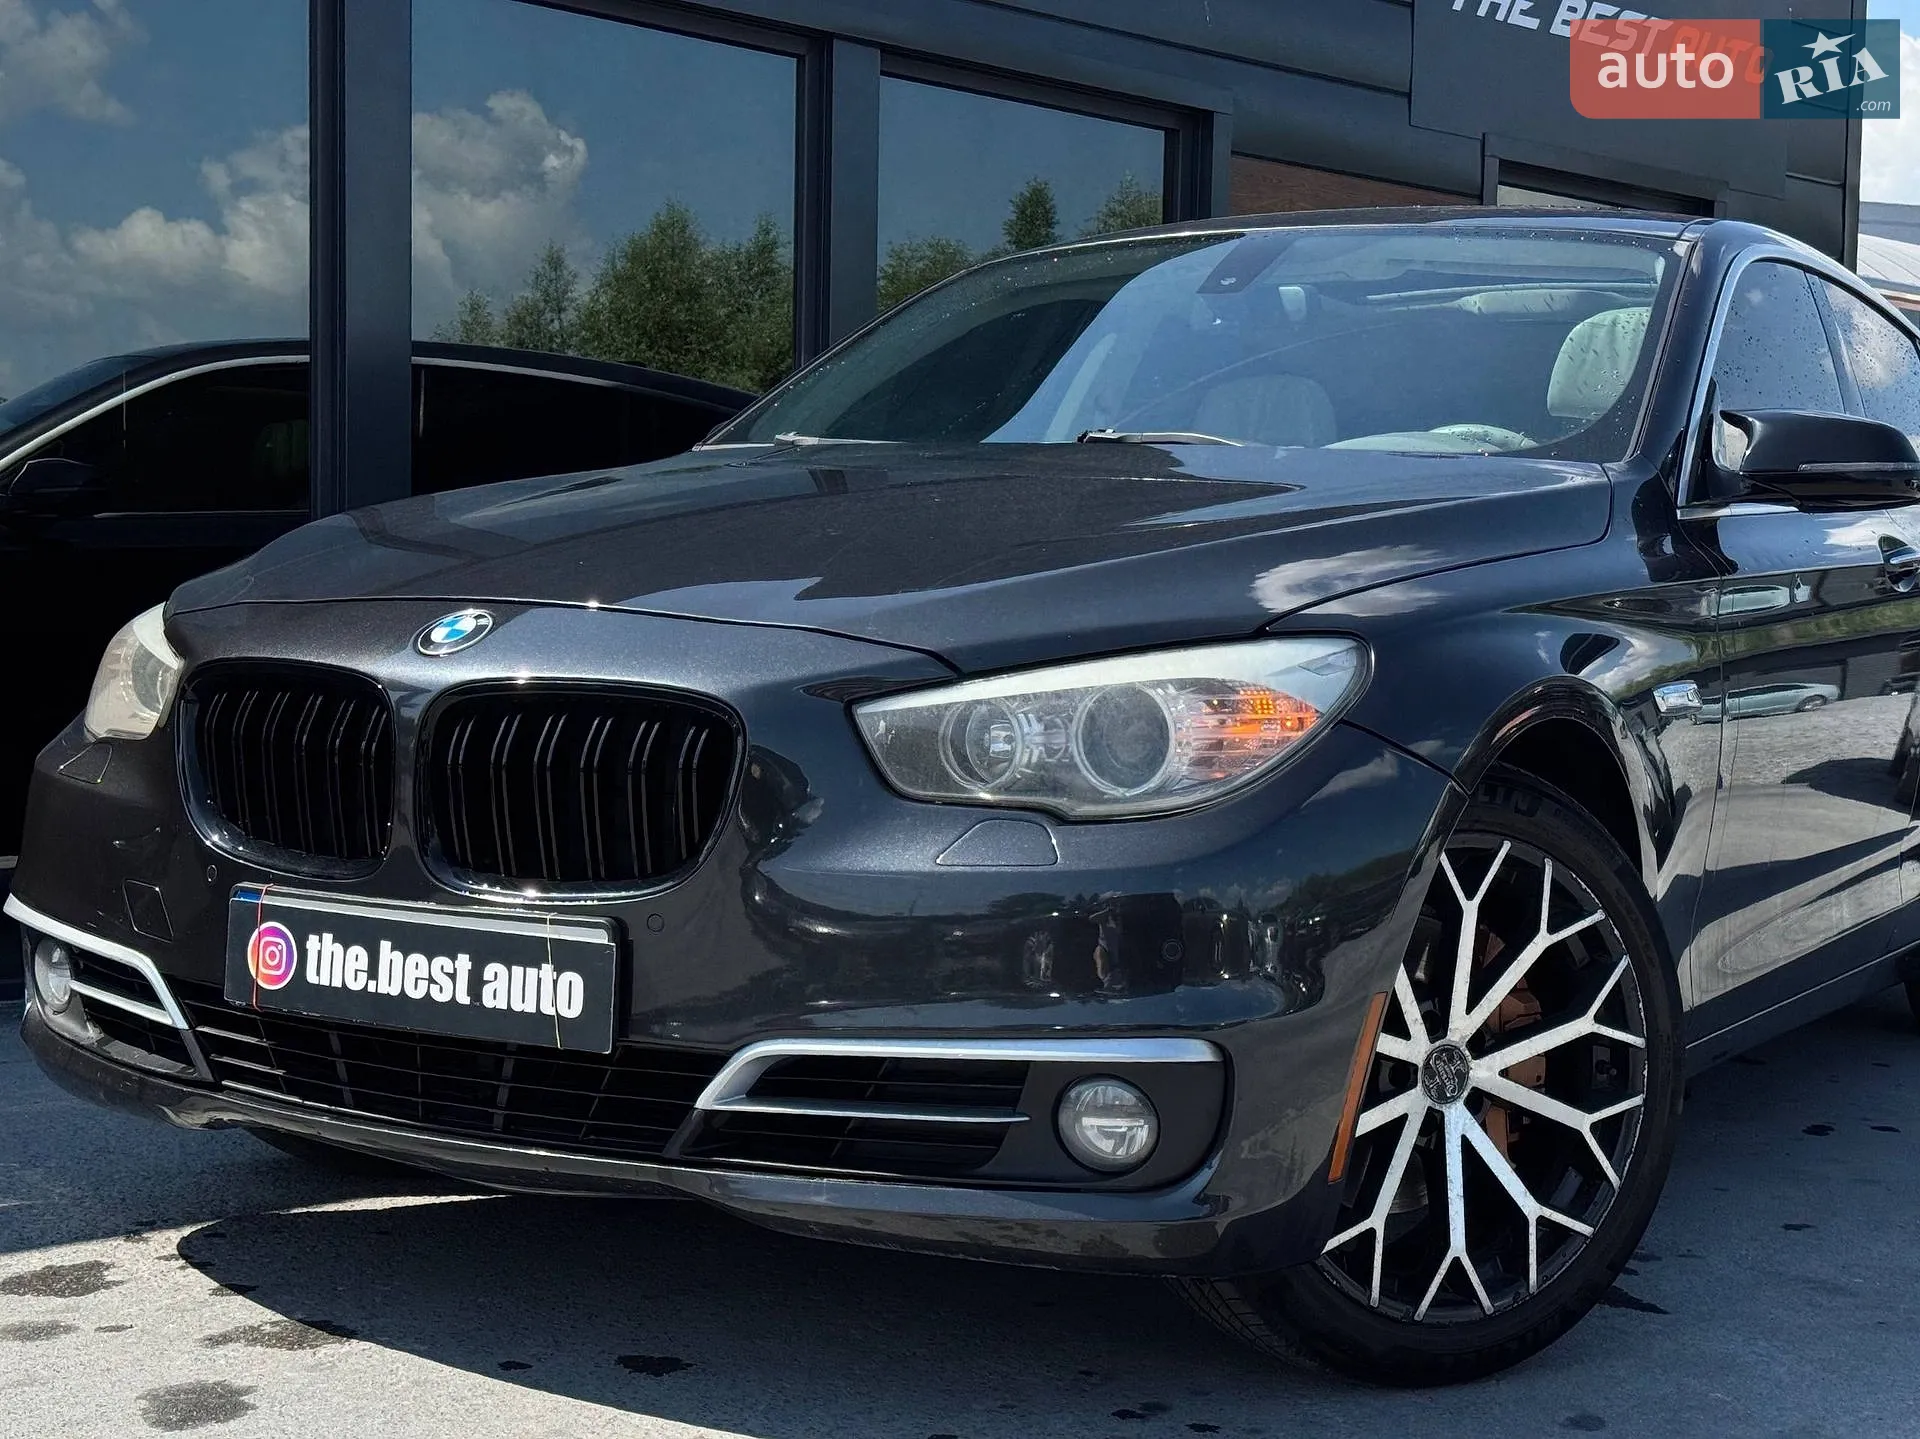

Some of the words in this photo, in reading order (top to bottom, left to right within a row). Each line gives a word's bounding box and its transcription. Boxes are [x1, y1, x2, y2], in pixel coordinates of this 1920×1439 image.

[1452, 0, 1540, 30] HE
[1550, 0, 1675, 57] BEST
[305, 932, 472, 1004] the.best
[482, 962, 584, 1018] auto
